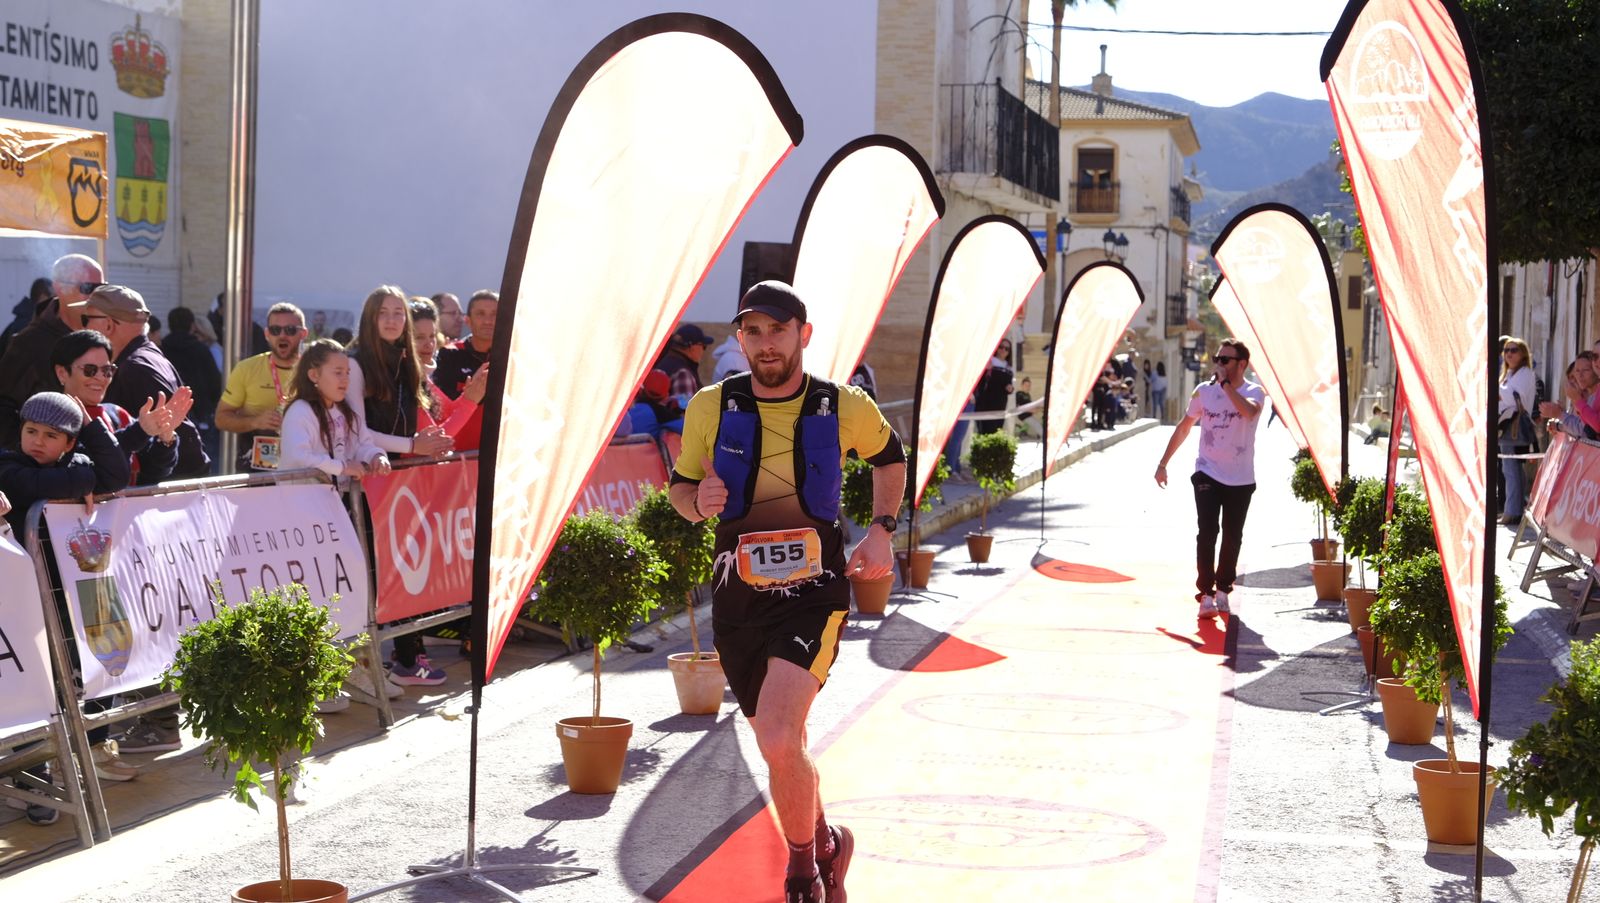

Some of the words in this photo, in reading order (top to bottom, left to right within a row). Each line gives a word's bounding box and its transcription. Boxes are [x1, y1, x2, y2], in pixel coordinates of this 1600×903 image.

[0, 21, 98, 72] ENTÍSIMO
[0, 74, 98, 121] TAMIENTO
[131, 527, 305, 571] AYUNTAMIENTO
[313, 522, 340, 545] DE
[751, 543, 804, 565] 155
[140, 552, 353, 633] CANTORIA
